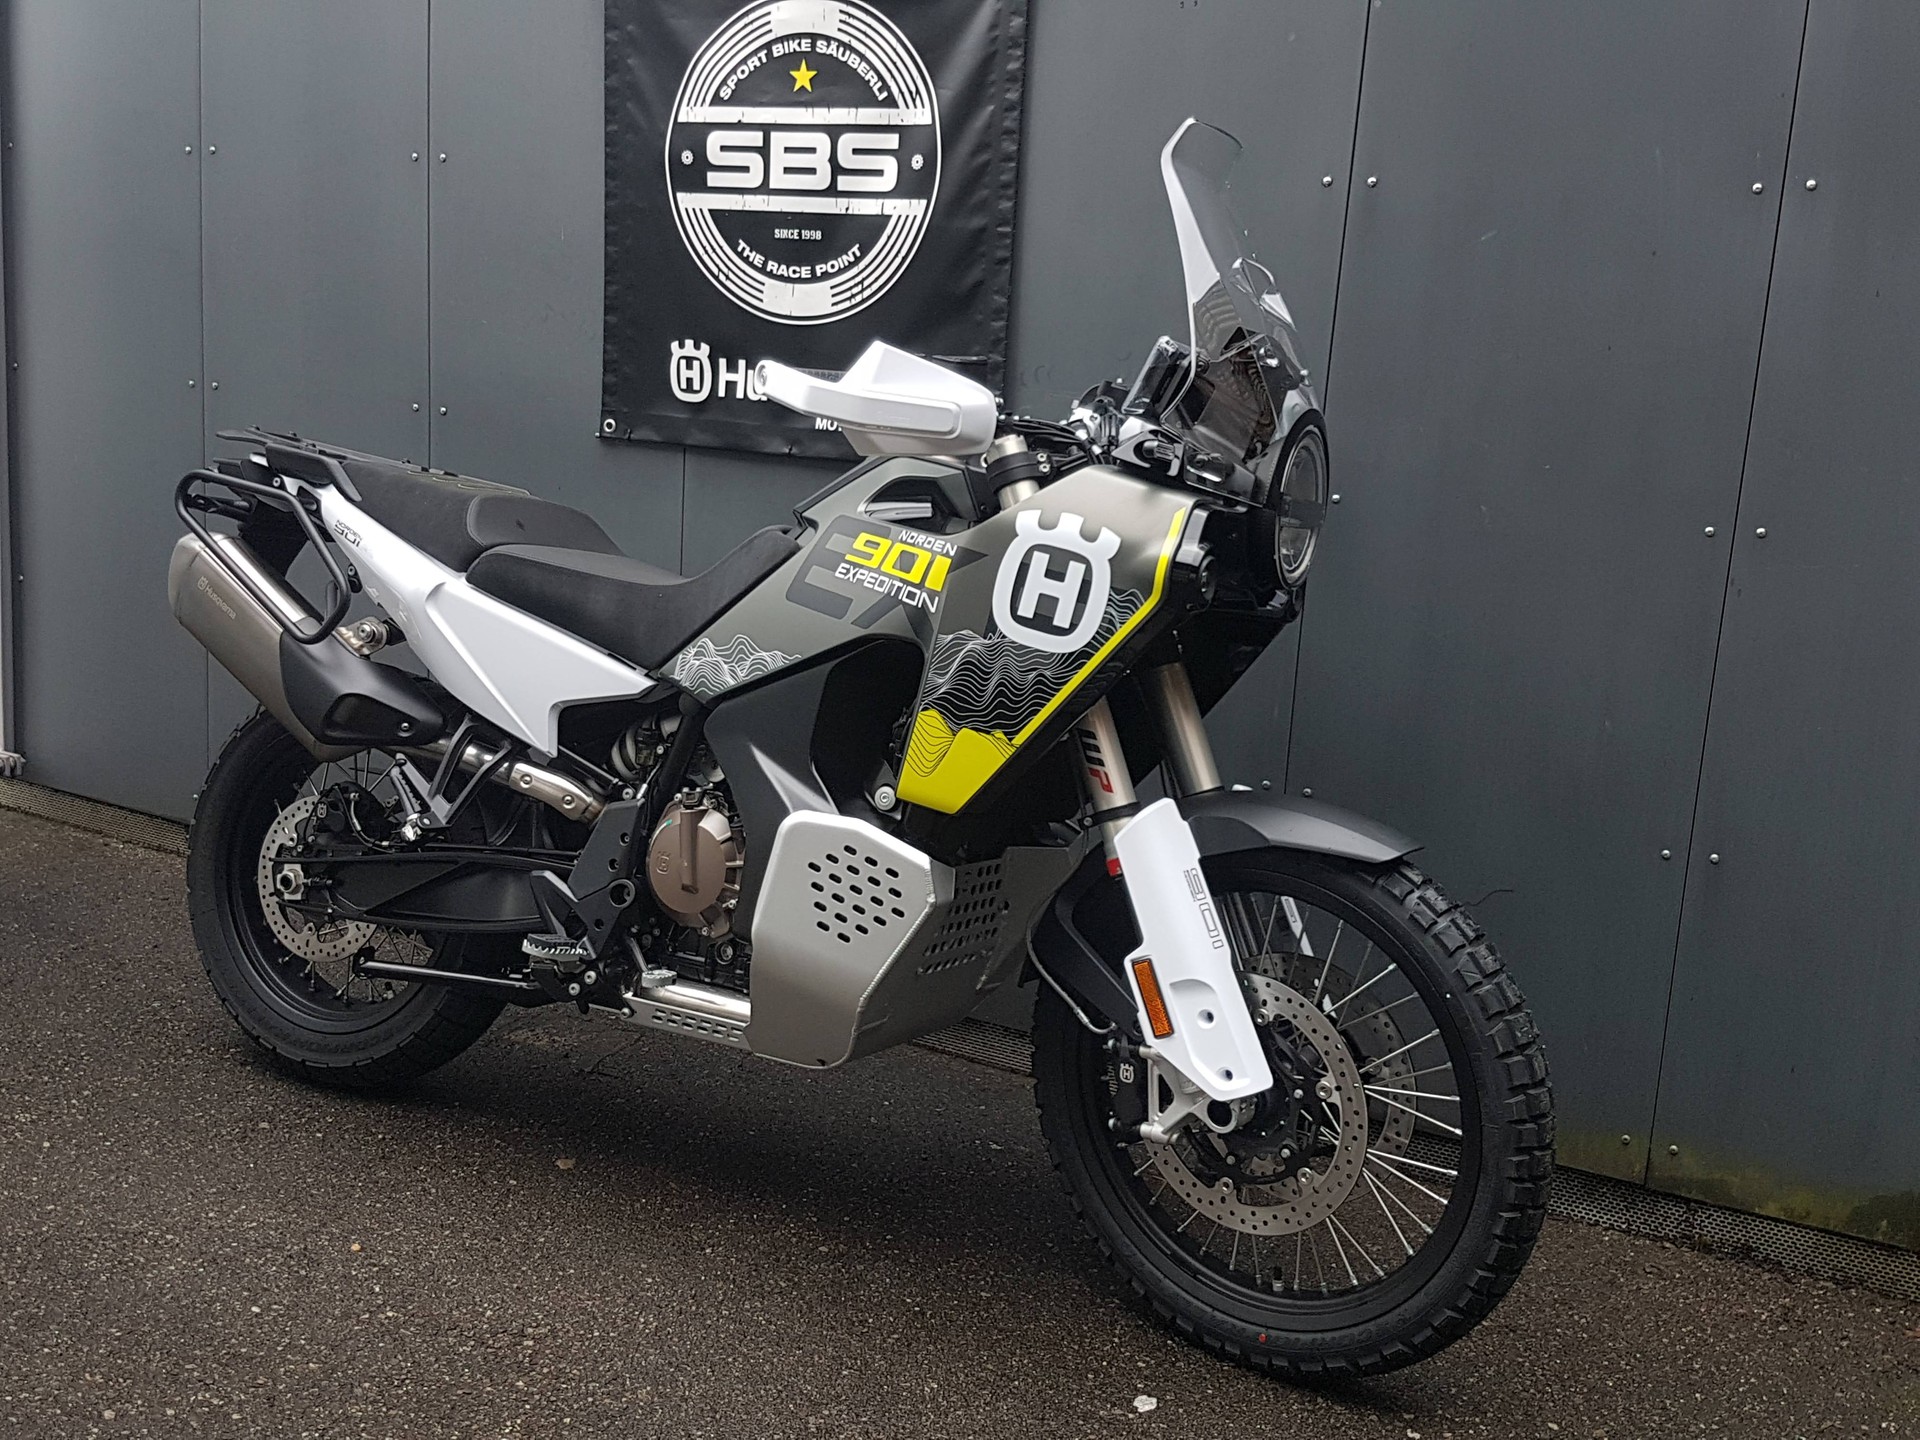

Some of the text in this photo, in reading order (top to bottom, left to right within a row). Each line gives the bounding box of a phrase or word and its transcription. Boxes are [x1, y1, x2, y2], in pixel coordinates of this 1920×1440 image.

[719, 38, 889, 102] SPORT BIKE SÄUBERLI
[706, 130, 900, 193] SBS
[774, 228, 822, 241] SINCE 1998
[736, 238, 861, 279] THE RACE POINT
[718, 357, 768, 401] Hu
[815, 416, 842, 432] MO
[844, 531, 953, 592] 901
[898, 529, 958, 557] NORDEN
[834, 562, 939, 614] EXPEDITION
